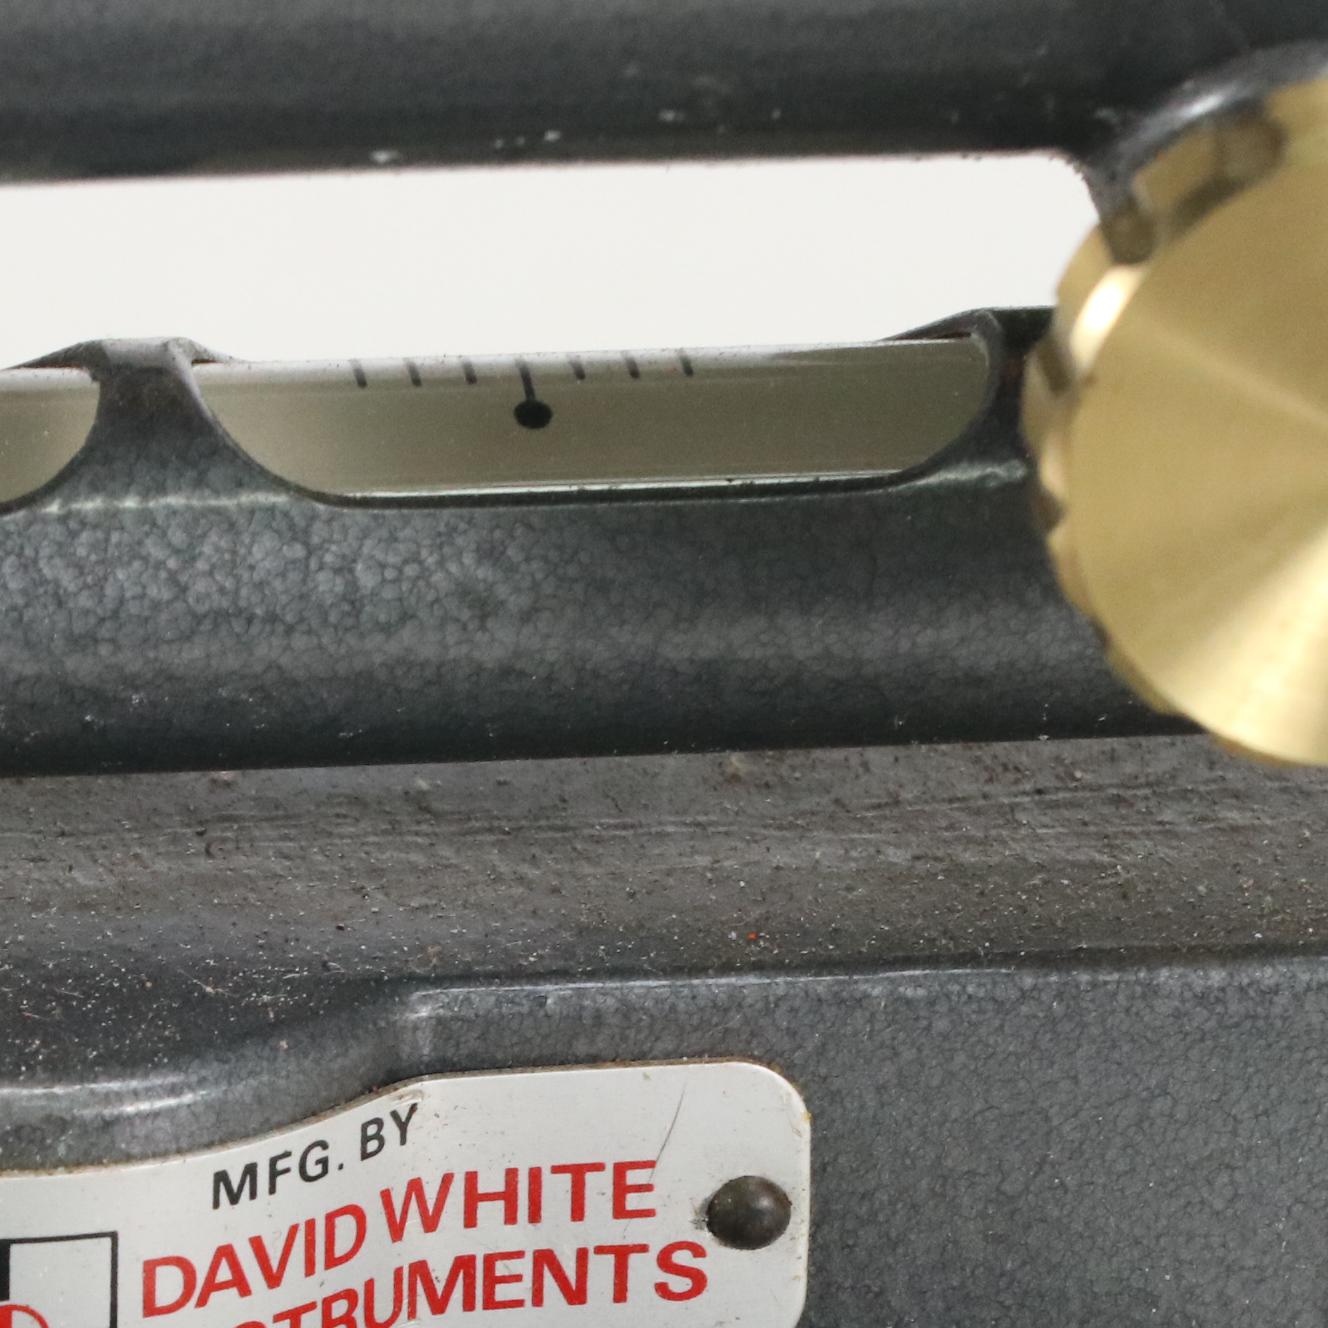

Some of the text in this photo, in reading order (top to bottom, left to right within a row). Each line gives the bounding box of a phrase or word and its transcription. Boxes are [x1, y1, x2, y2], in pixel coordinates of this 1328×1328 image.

[210, 1103, 420, 1211] MFG. BY
[141, 1159, 659, 1319] DAVID WHITE
